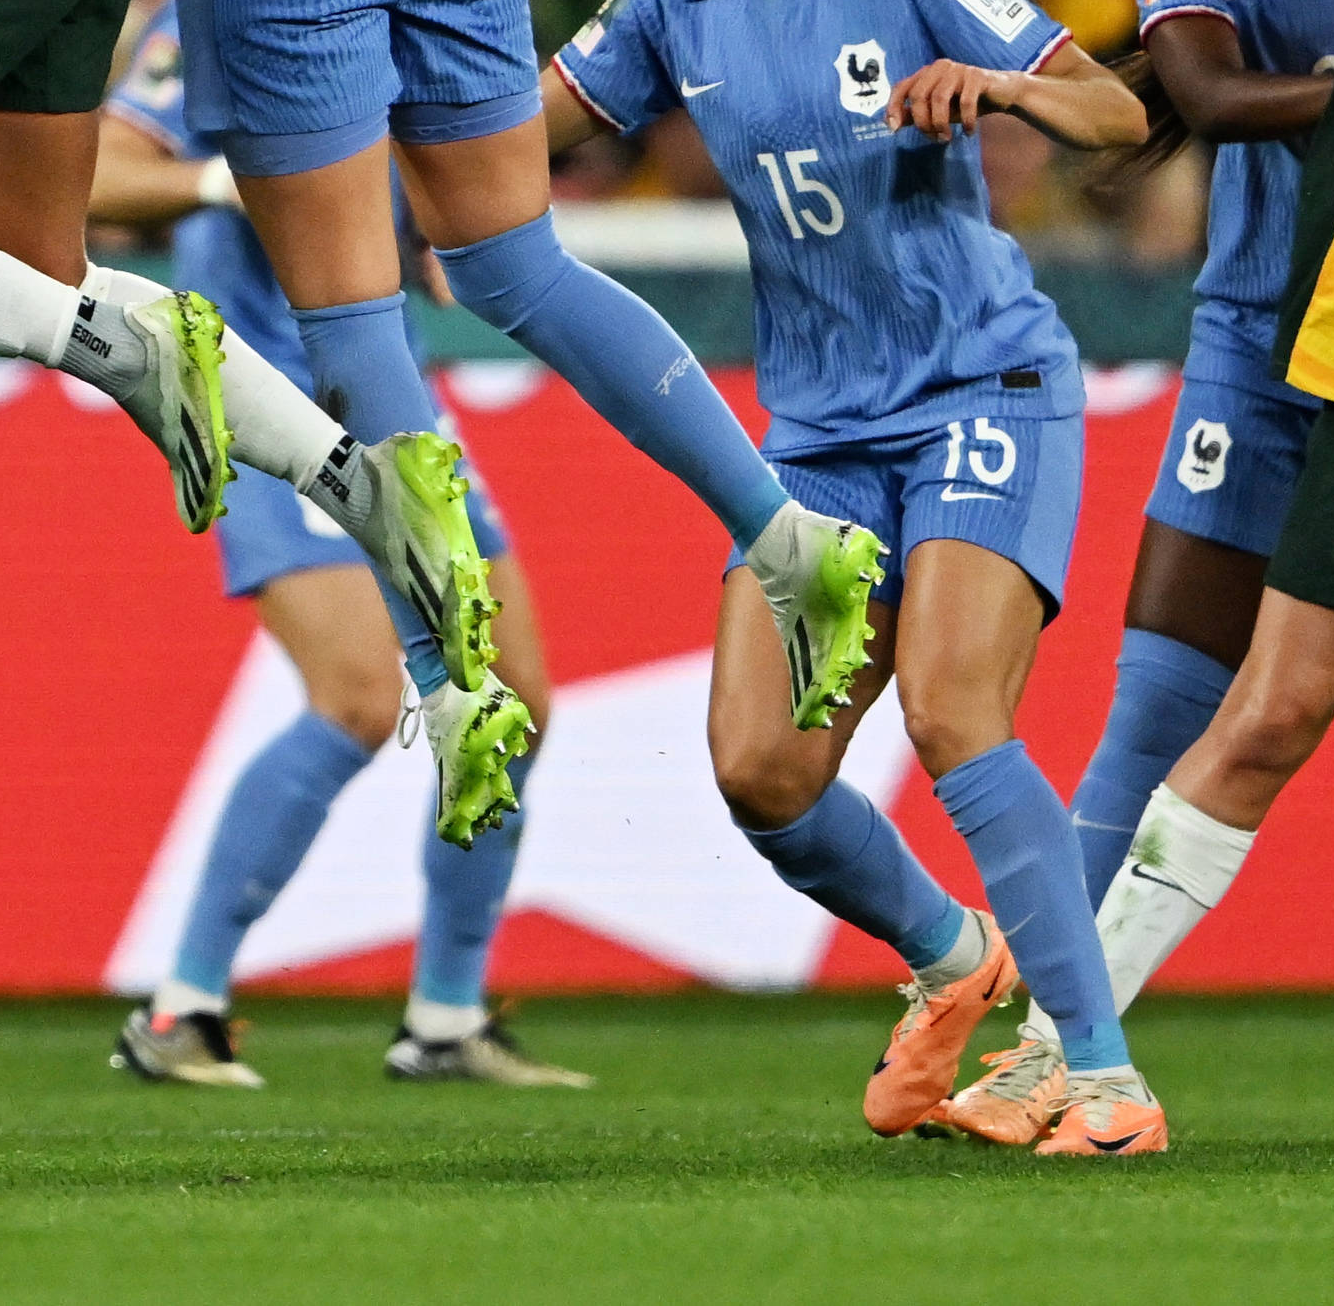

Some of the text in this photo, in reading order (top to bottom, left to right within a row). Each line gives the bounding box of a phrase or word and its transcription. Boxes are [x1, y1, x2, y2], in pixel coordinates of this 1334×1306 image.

[756, 148, 845, 239] 15
[70, 321, 113, 359] ESIGN
[943, 417, 1017, 486] 15
